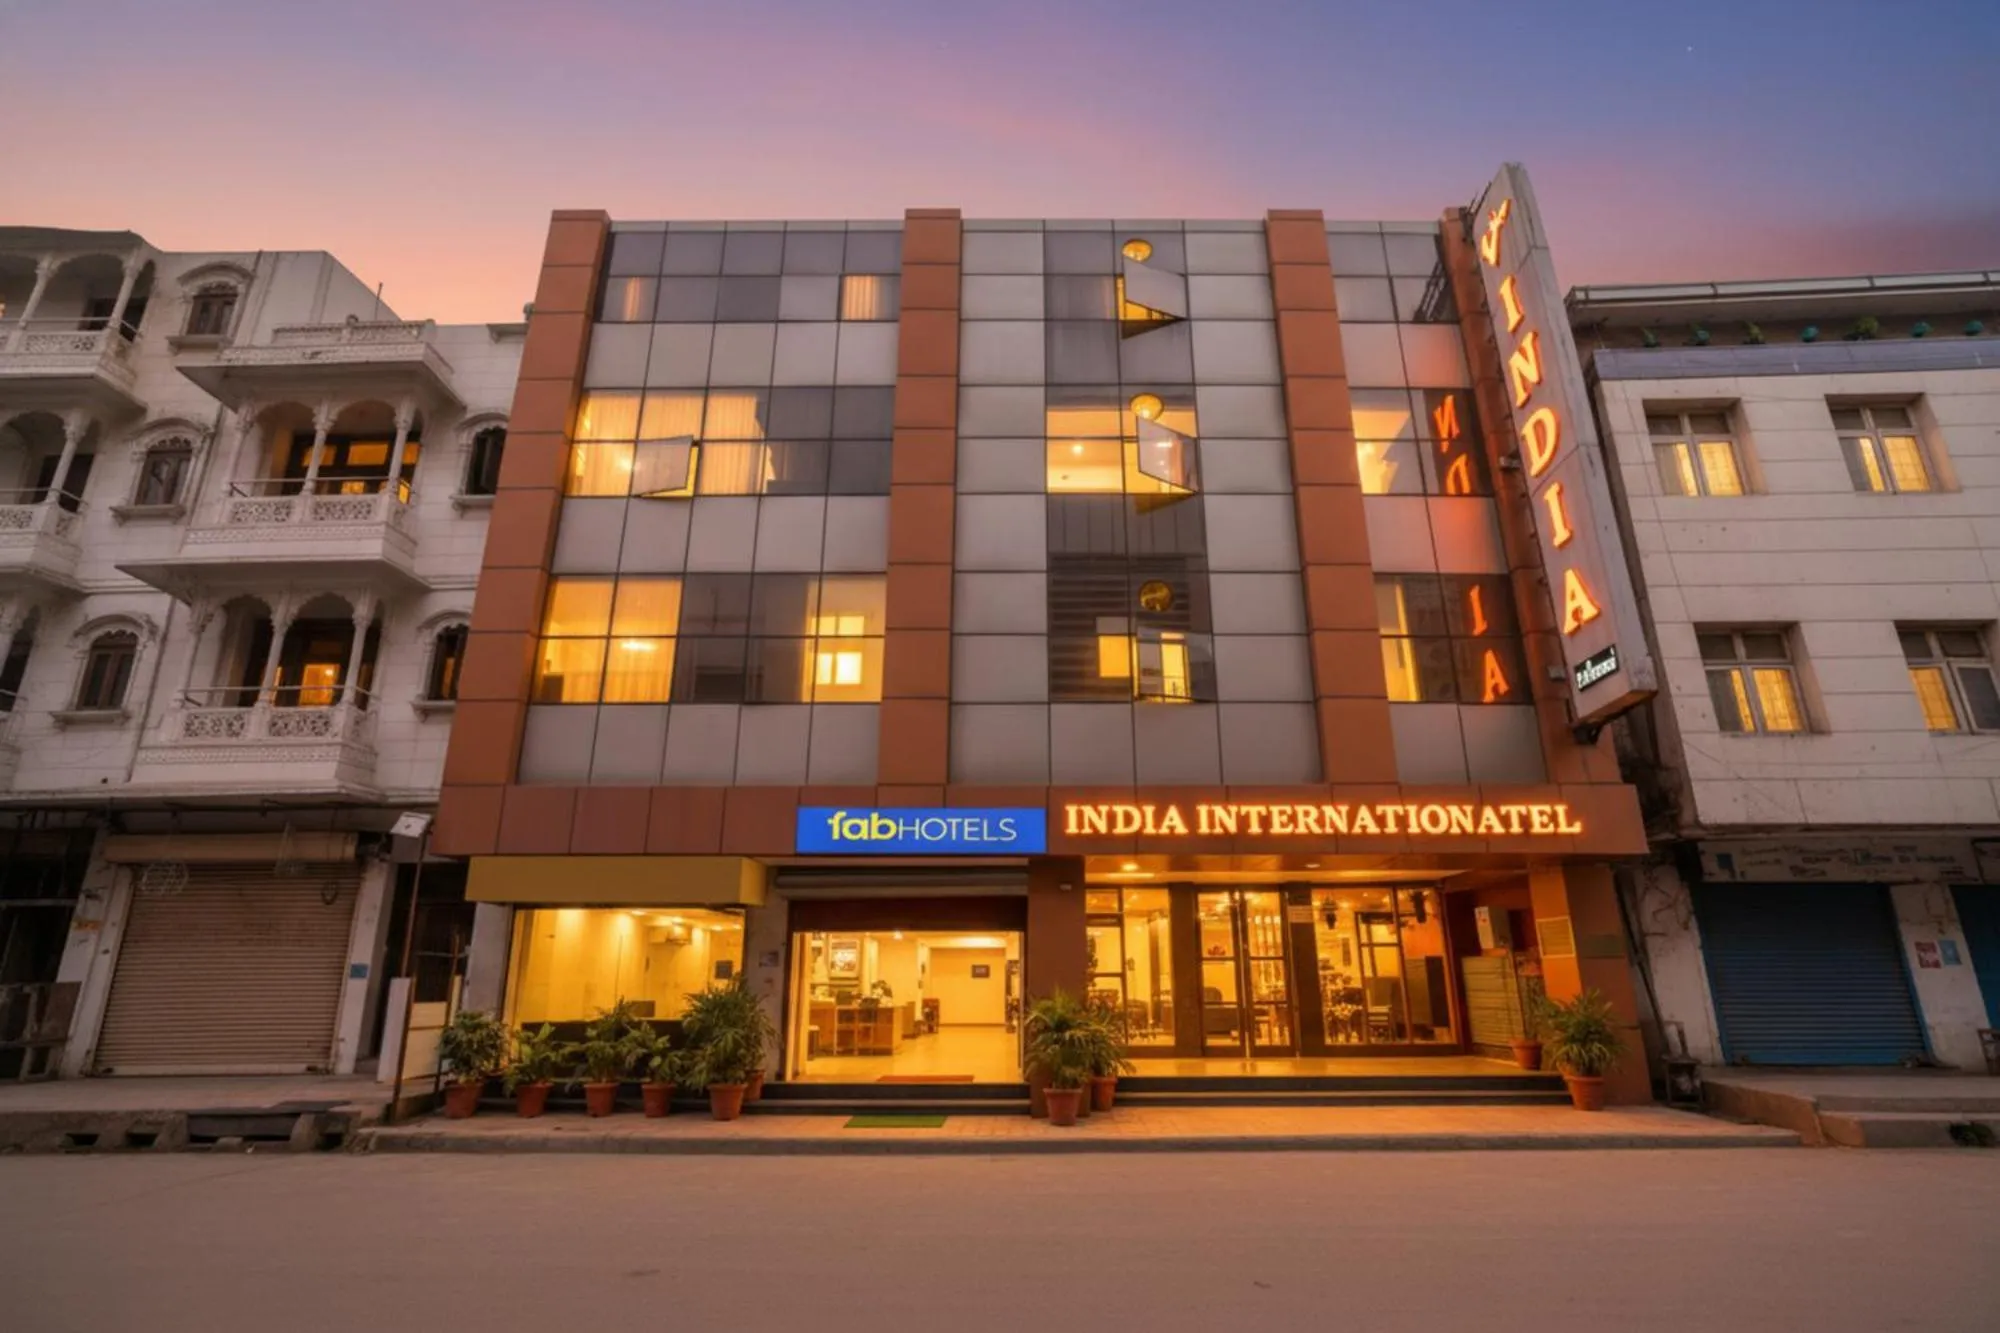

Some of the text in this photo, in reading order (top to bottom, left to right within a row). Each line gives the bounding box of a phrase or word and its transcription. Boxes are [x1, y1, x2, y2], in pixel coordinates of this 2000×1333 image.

[1498, 274, 1602, 637] INDIA
[1064, 803, 1583, 835] INDIA INTERNATIONATEL
